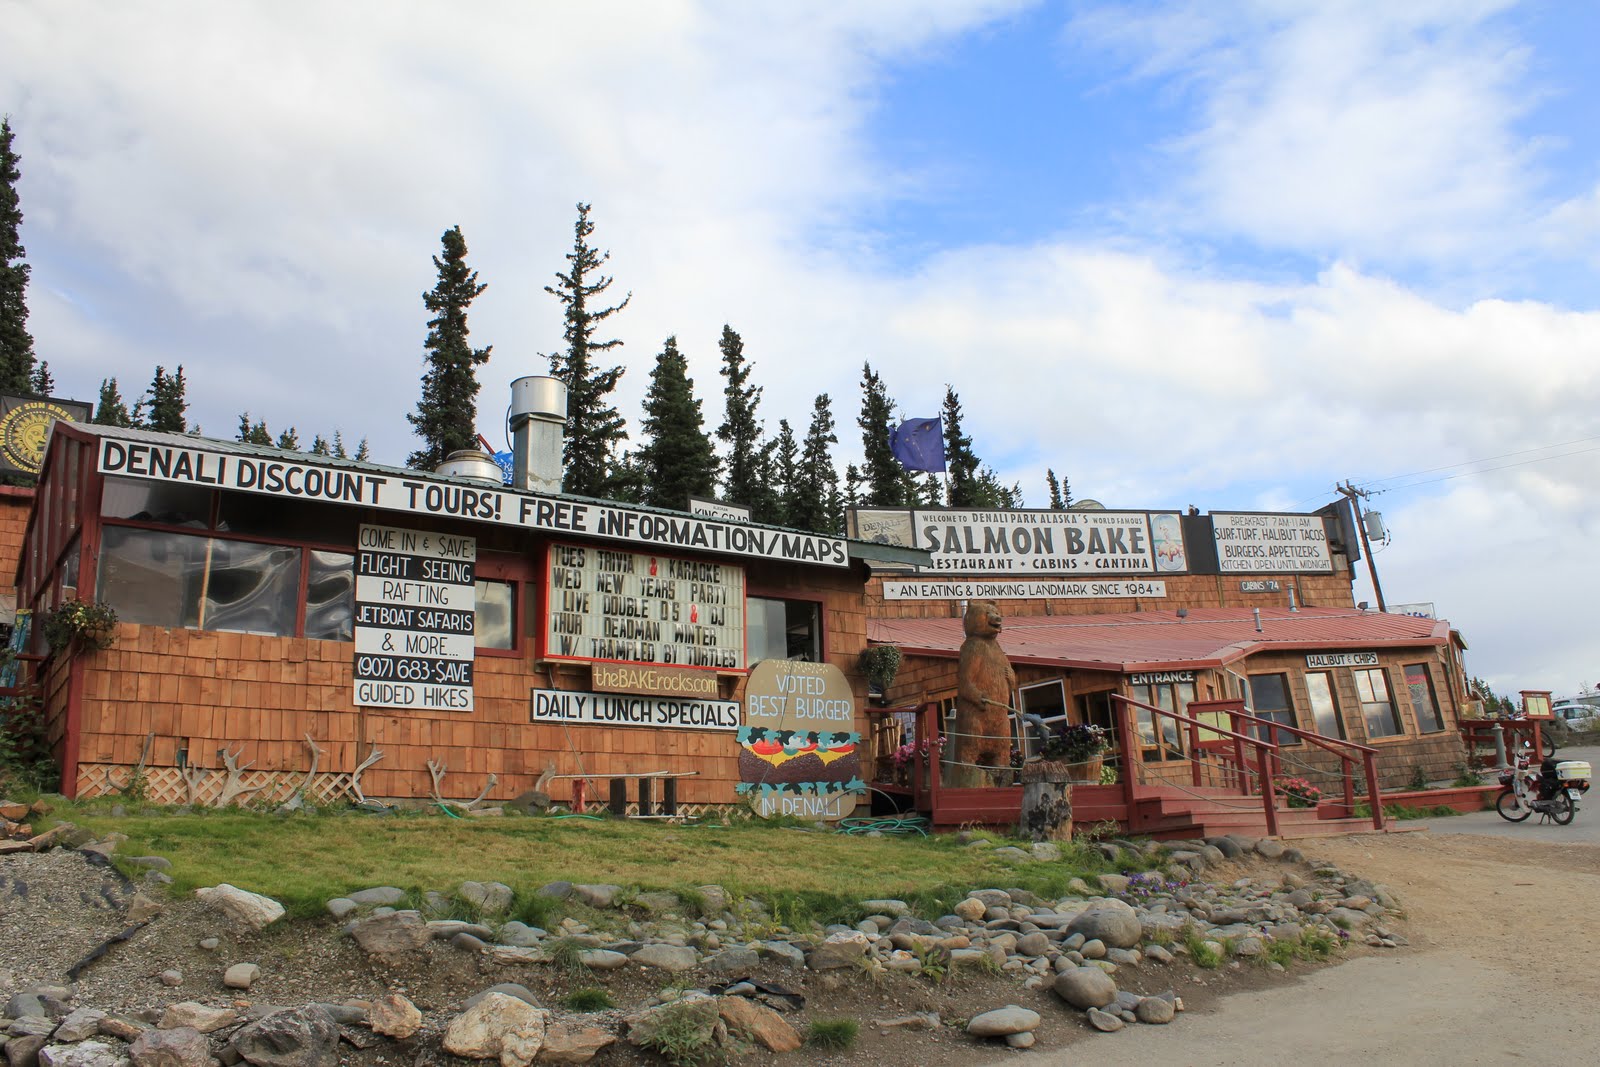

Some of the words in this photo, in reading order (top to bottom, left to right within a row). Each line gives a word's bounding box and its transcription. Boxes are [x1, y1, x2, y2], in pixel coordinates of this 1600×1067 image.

[24, 402, 46, 410] SUN
[103, 441, 227, 486] DENALI
[236, 459, 388, 505] DISCOUNT
[402, 481, 502, 521] TOURS!
[519, 497, 588, 532] FREE
[862, 520, 902, 532] DENALI
[922, 515, 957, 523] WELCOME
[958, 515, 968, 523] TO
[971, 512, 1008, 523] DENALI
[1010, 513, 1037, 524] PARK
[1040, 513, 1089, 524] ALASKA'S
[1092, 517, 1116, 525] WORLD
[1117, 517, 1143, 525] FAMOUS
[1230, 516, 1268, 527] BREAKFAST
[360, 527, 396, 550] COME
[401, 532, 417, 552] IN
[422, 536, 430, 551] &
[923, 525, 1054, 555] SALMON
[1063, 526, 1146, 555] BAKE
[1262, 528, 1297, 541] HALIBUT
[1299, 529, 1326, 541] TACOS
[1032, 558, 1078, 570] CABINS
[1095, 558, 1149, 569] CANTINA
[1268, 545, 1320, 558] APPETIZERS
[359, 553, 412, 577] FLIGHT
[422, 559, 471, 583] SEEING
[553, 545, 586, 568] TUES
[597, 550, 635, 574] TRIVIA
[650, 557, 658, 577] &
[669, 559, 721, 584] KARAOKE
[1220, 559, 1252, 570] KITCHEN
[1254, 559, 1276, 570] OPEN
[1277, 559, 1299, 570] UNTIL
[1299, 559, 1331, 570] MIDNIGHT
[382, 580, 449, 605] RAFTING
[553, 567, 582, 590] WED
[596, 572, 625, 595] NEW
[639, 576, 676, 600] YEARS
[691, 583, 728, 606] PARTY
[900, 584, 918, 597] AN
[921, 584, 964, 597] EATING
[965, 584, 973, 597] &
[976, 584, 1025, 597] DRINKING
[1029, 584, 1088, 596] LANDMARK
[1091, 583, 1121, 595] SINCE
[1124, 583, 1153, 595] 1984
[1241, 581, 1265, 591] CABINS
[356, 605, 415, 627] JETBOAT
[417, 610, 473, 631] SAFARIS
[563, 590, 590, 614] LIVE
[603, 595, 649, 619] DOUBLE
[690, 604, 699, 624] &
[710, 605, 726, 627] DJ
[381, 632, 395, 652] &
[552, 612, 583, 636] THUR
[603, 616, 661, 642] DEADMAN
[674, 623, 717, 647] WINTER
[560, 634, 580, 657] W/
[591, 638, 655, 664] TRAMPLED
[663, 643, 680, 664] BY
[686, 646, 737, 669] TURTLES
[1308, 654, 1346, 667] HALIBUT
[1353, 652, 1377, 664] CHIPS
[357, 656, 395, 678] (907)
[397, 659, 470, 684] 683-$AVE
[592, 667, 718, 695] theBAKErocks.com
[1131, 670, 1195, 685] ENTRANCE
[358, 682, 415, 705] GUIDED
[423, 686, 469, 708] HIKES
[776, 674, 826, 696] VOTED
[536, 693, 587, 720] DAILY
[592, 697, 652, 723] LUNCH
[656, 701, 738, 728] SPECIALS
[750, 695, 788, 717] BEST
[795, 697, 851, 721] BURGER
[761, 797, 776, 816] IN
[782, 797, 841, 817] DENALI
